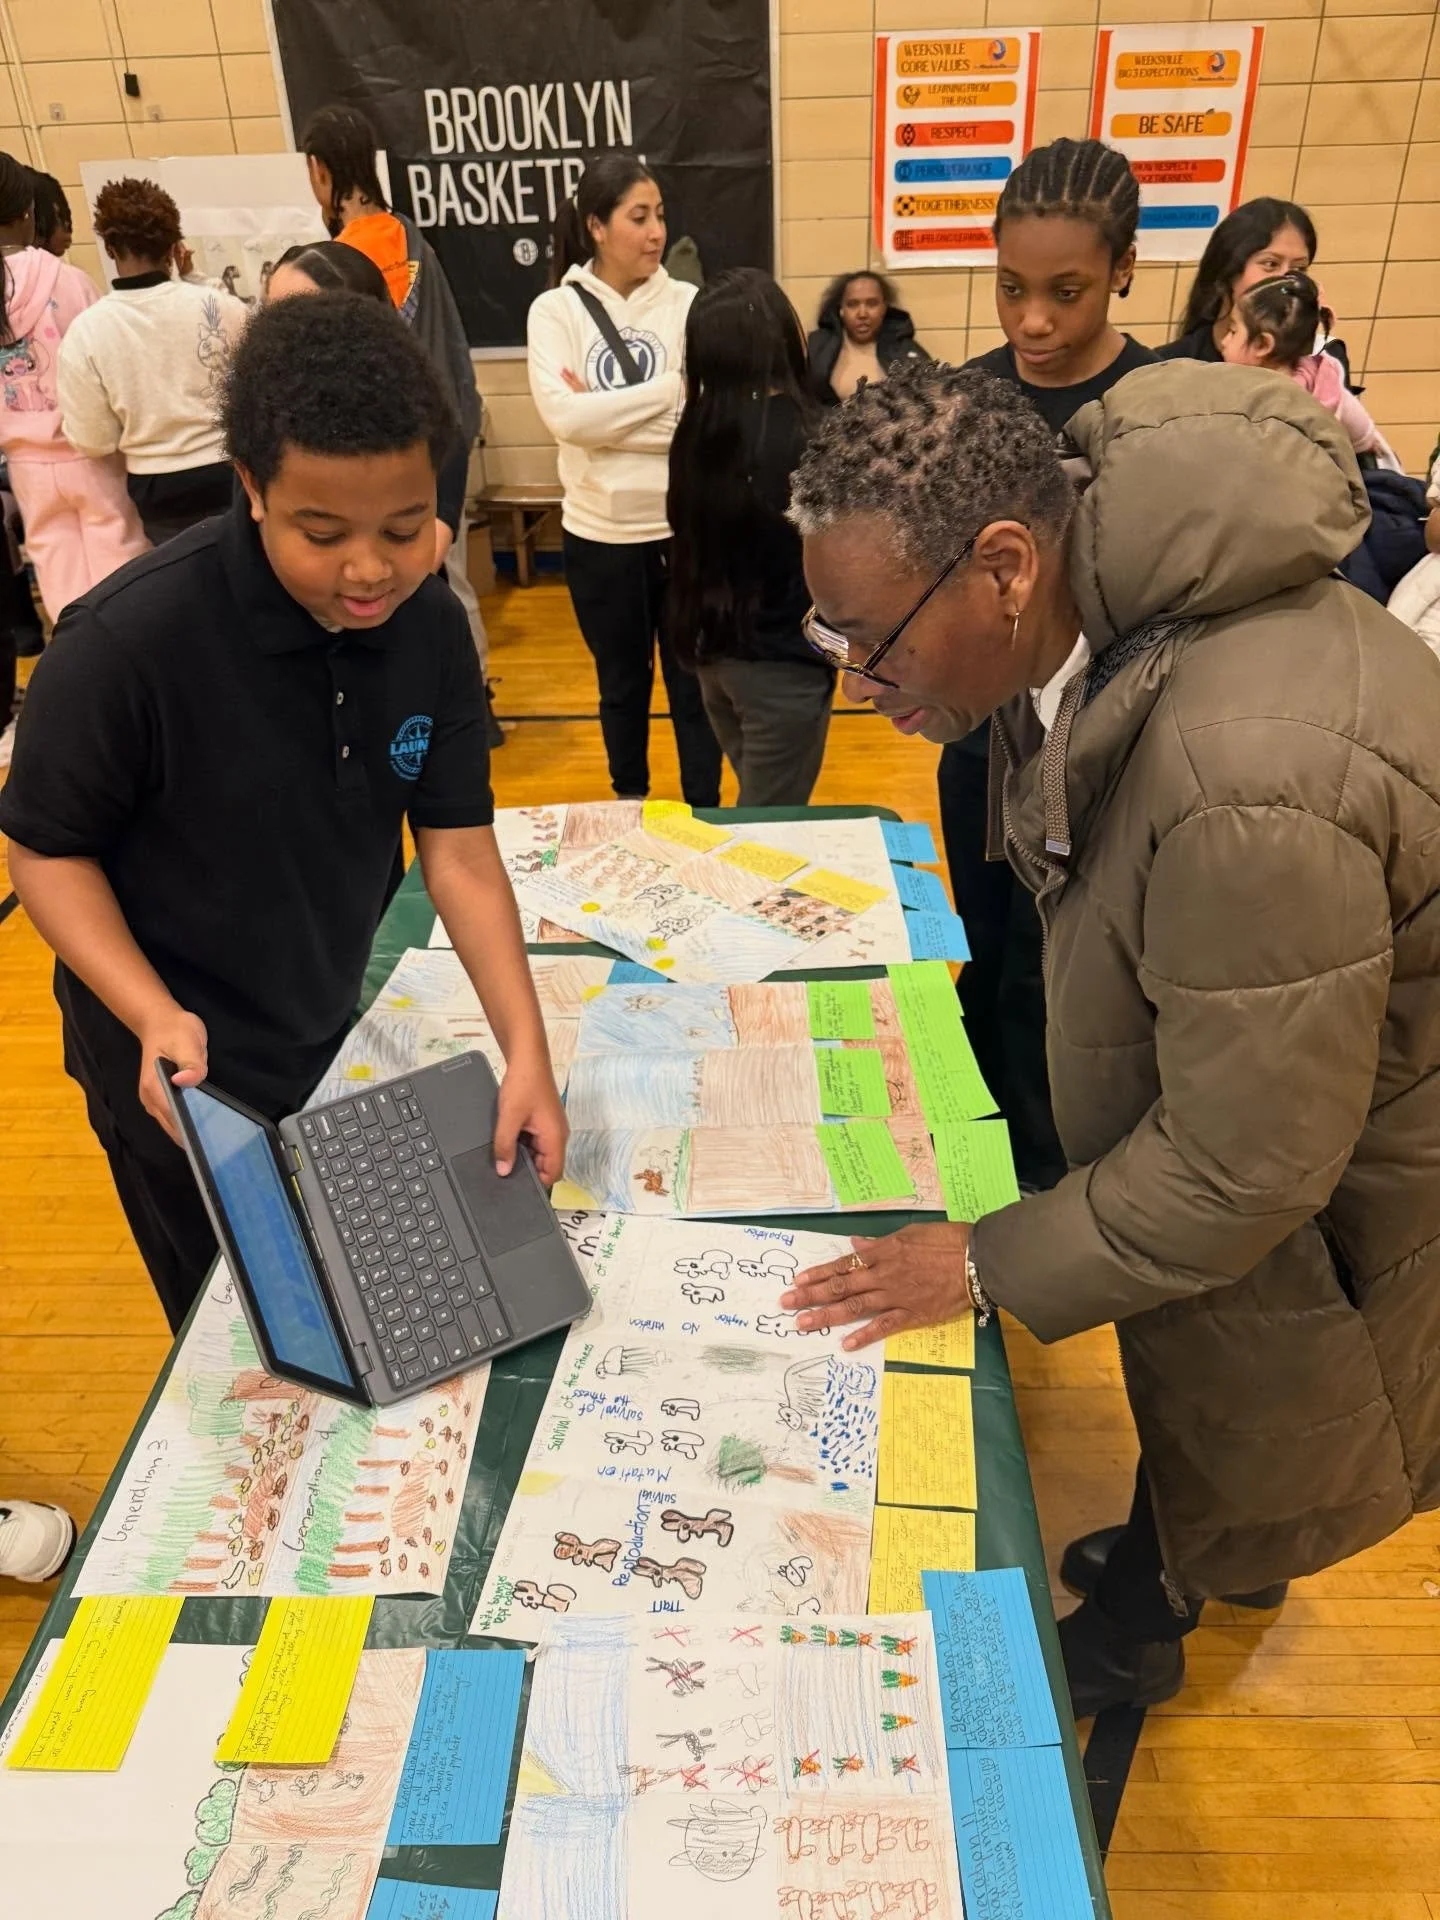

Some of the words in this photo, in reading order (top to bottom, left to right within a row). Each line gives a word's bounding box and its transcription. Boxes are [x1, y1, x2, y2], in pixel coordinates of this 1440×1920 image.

[904, 43, 965, 57] WEEKSVILLE
[901, 59, 932, 73] CORE
[932, 60, 970, 72] VALUES
[425, 80, 633, 154] BROOKLYN
[1139, 115, 1159, 134] BE
[1163, 114, 1205, 133] SAFE
[931, 126, 979, 139] RESPECT
[915, 198, 995, 212] TOGETHERNESS
[147, 1439, 168, 1450] 3
[936, 1630, 950, 1644] 12
[943, 1651, 967, 1733] generation
[968, 1834, 990, 1920] neration
